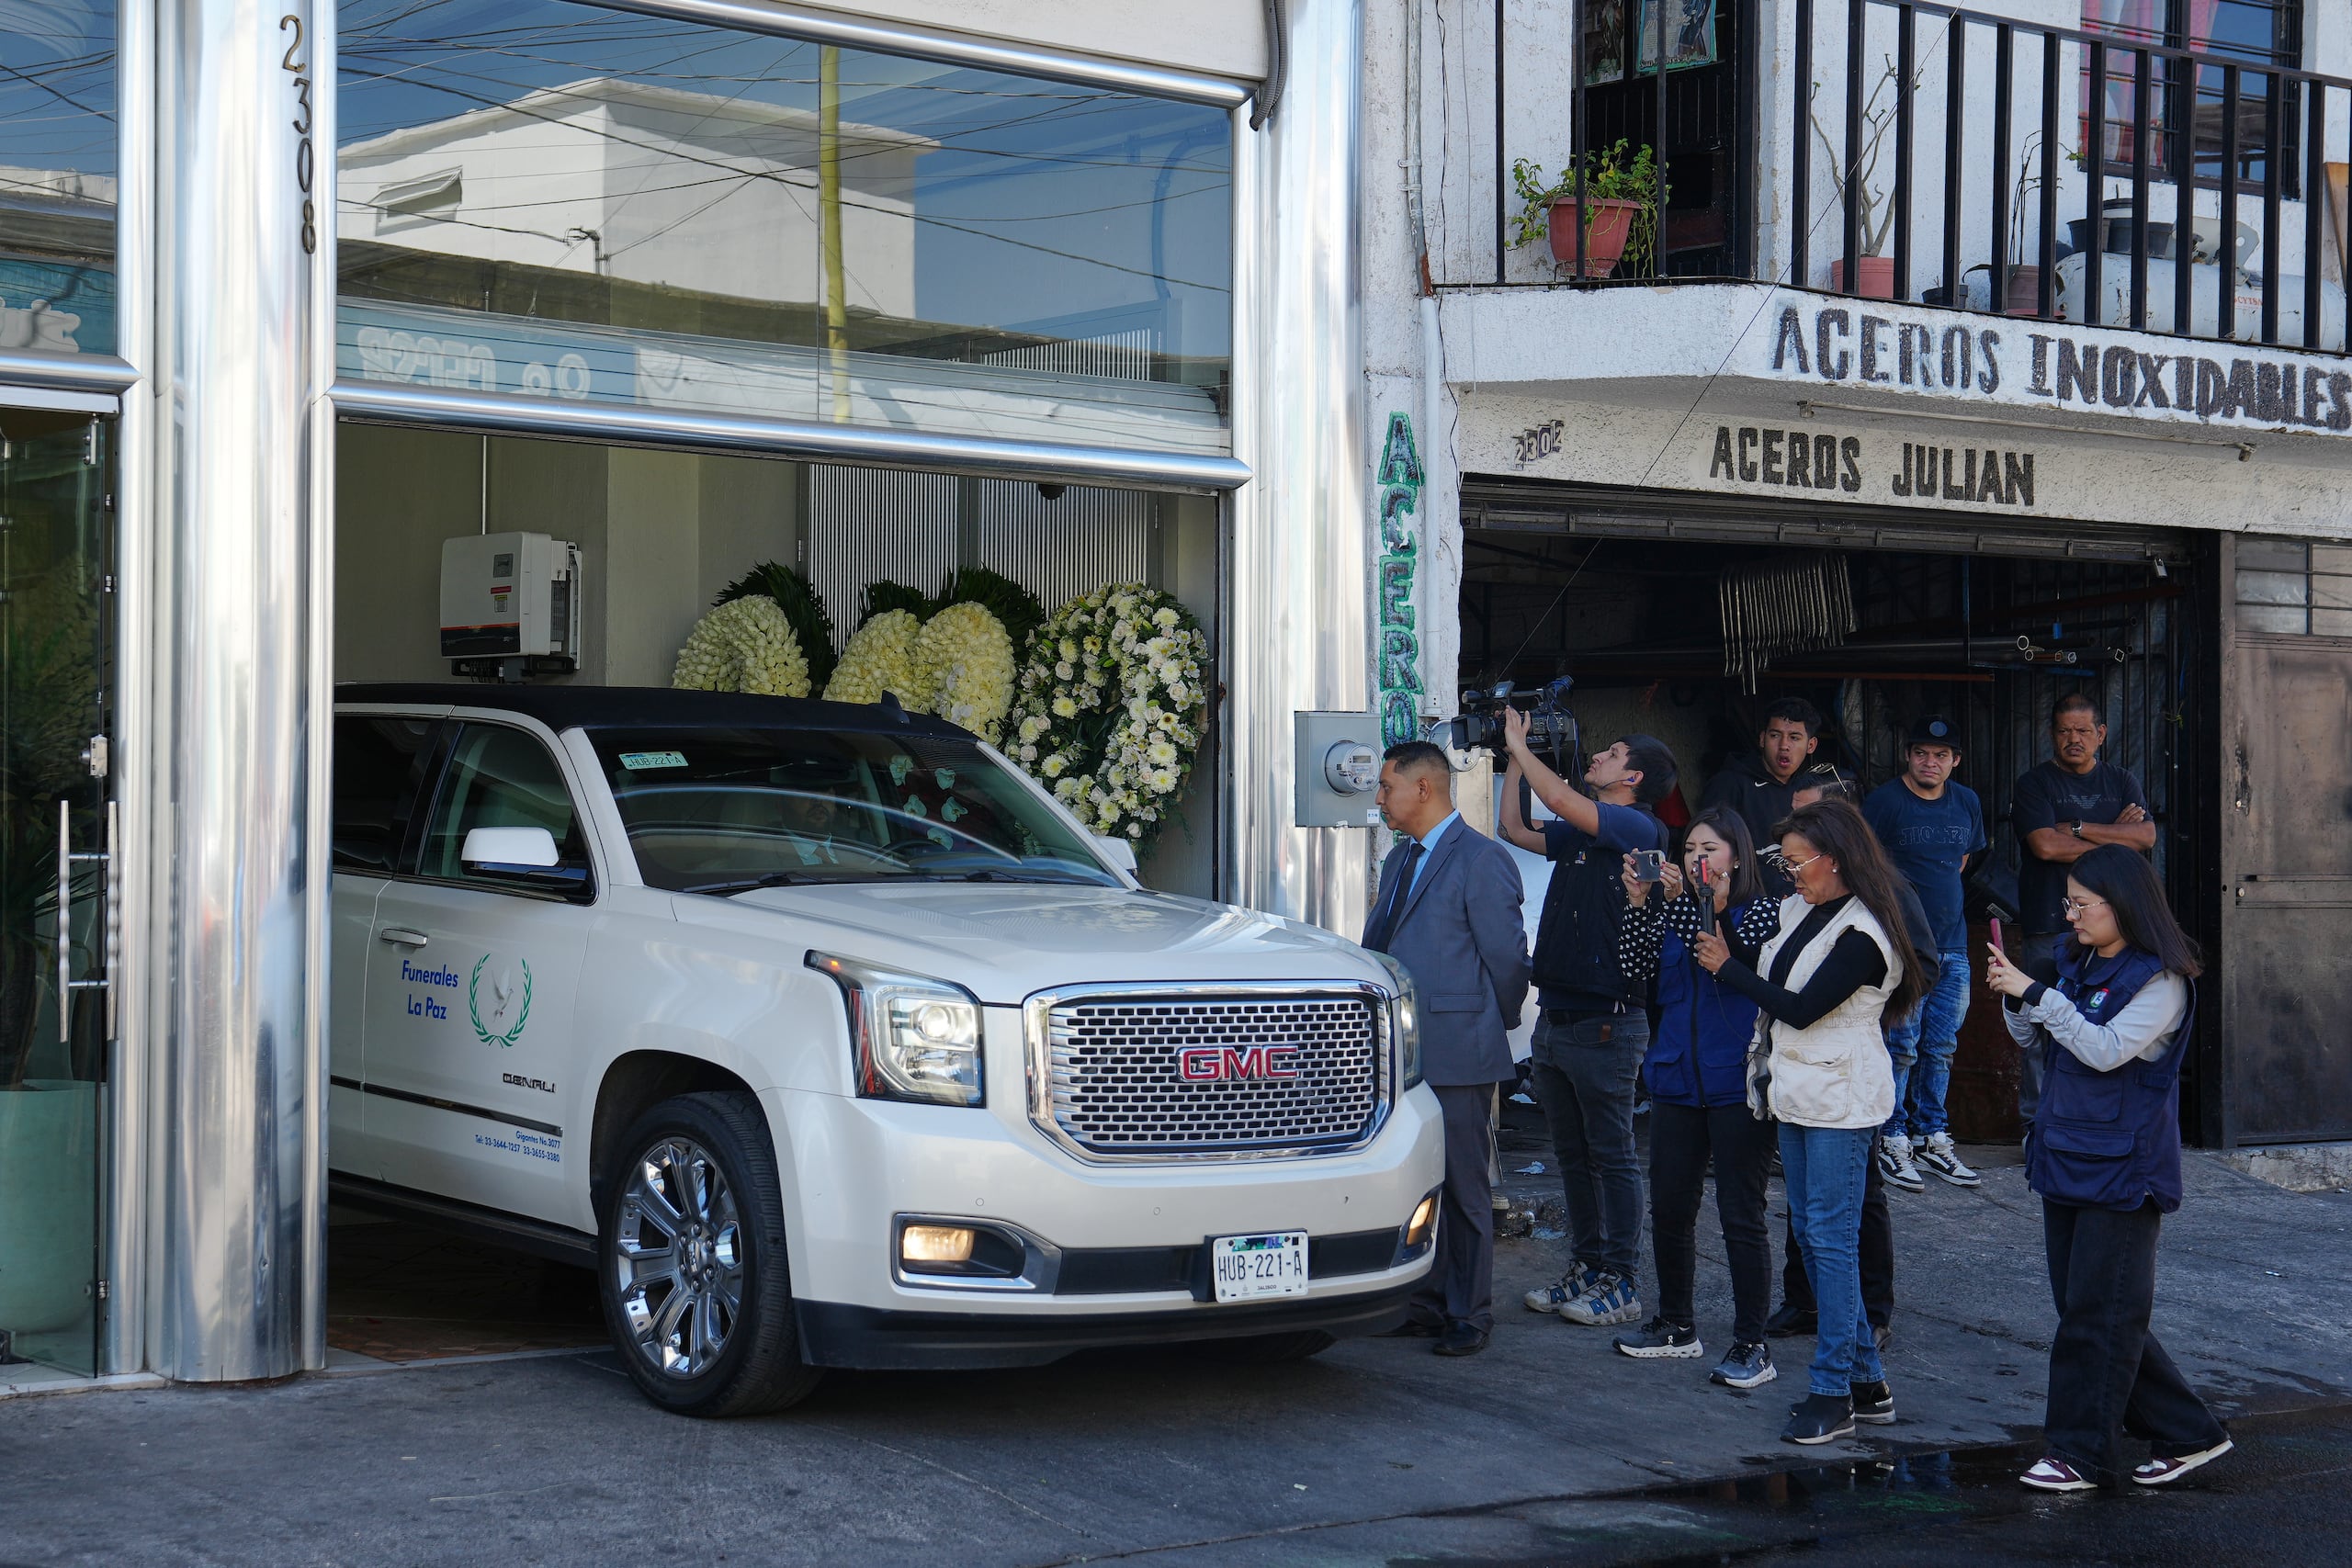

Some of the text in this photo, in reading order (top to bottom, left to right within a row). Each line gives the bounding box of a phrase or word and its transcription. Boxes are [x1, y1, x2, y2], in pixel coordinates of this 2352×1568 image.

[279, 14, 316, 254] 2308
[1771, 303, 2352, 432] ACEROS INOXIDABLES
[1513, 423, 1564, 465] 2302
[1709, 426, 2034, 506] ACEROS JULIAN
[1377, 411, 1425, 764] ACERO
[630, 756, 682, 766] HUB-221-A
[401, 960, 458, 987] Funerales
[408, 994, 447, 1020] La Paz
[1176, 1045, 1298, 1082] GMC
[503, 1073, 556, 1093] DENALI
[1218, 1250, 1303, 1281] HUB-221-A
